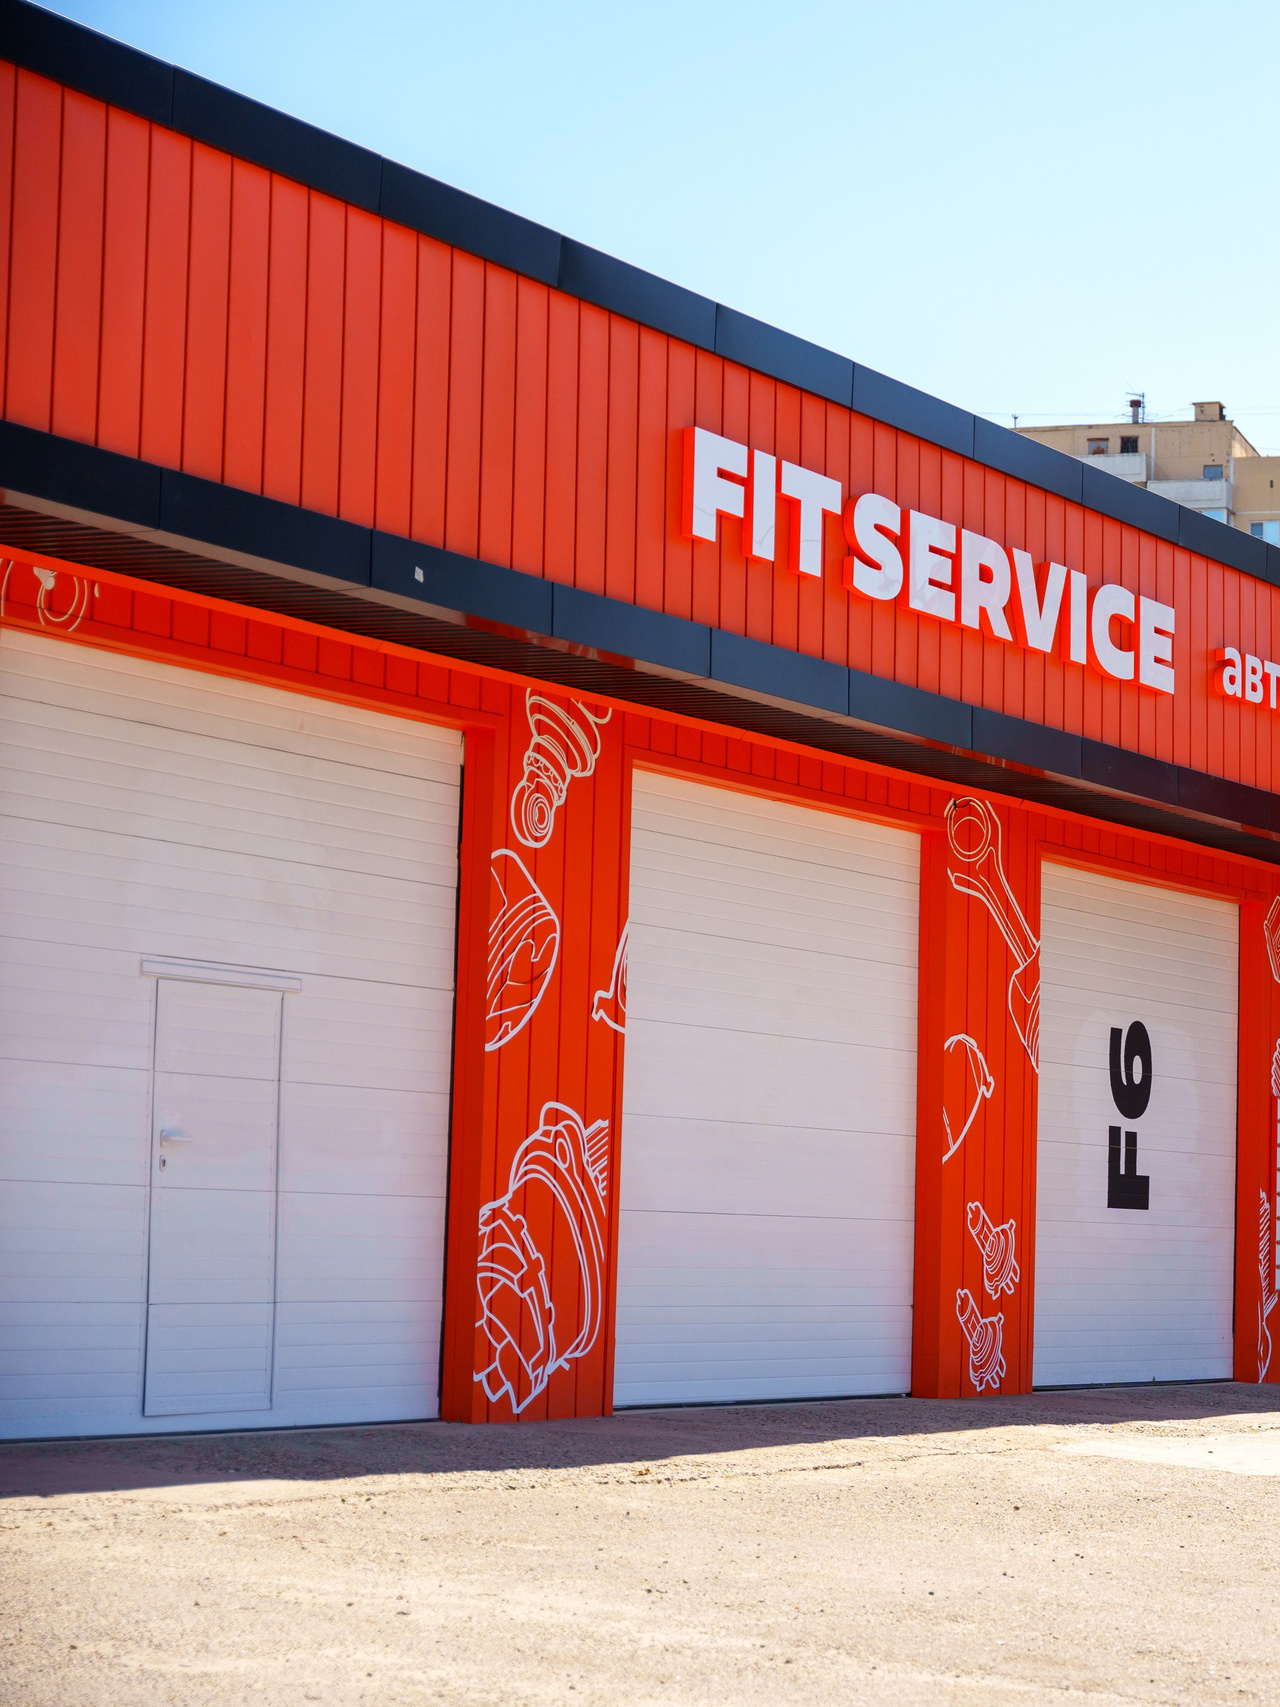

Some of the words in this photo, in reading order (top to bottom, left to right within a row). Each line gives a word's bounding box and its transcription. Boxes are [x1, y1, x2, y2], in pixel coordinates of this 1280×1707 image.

[691, 425, 842, 578] FIT
[852, 492, 1175, 695] SERVICE
[1107, 1020, 1153, 1211] F6
